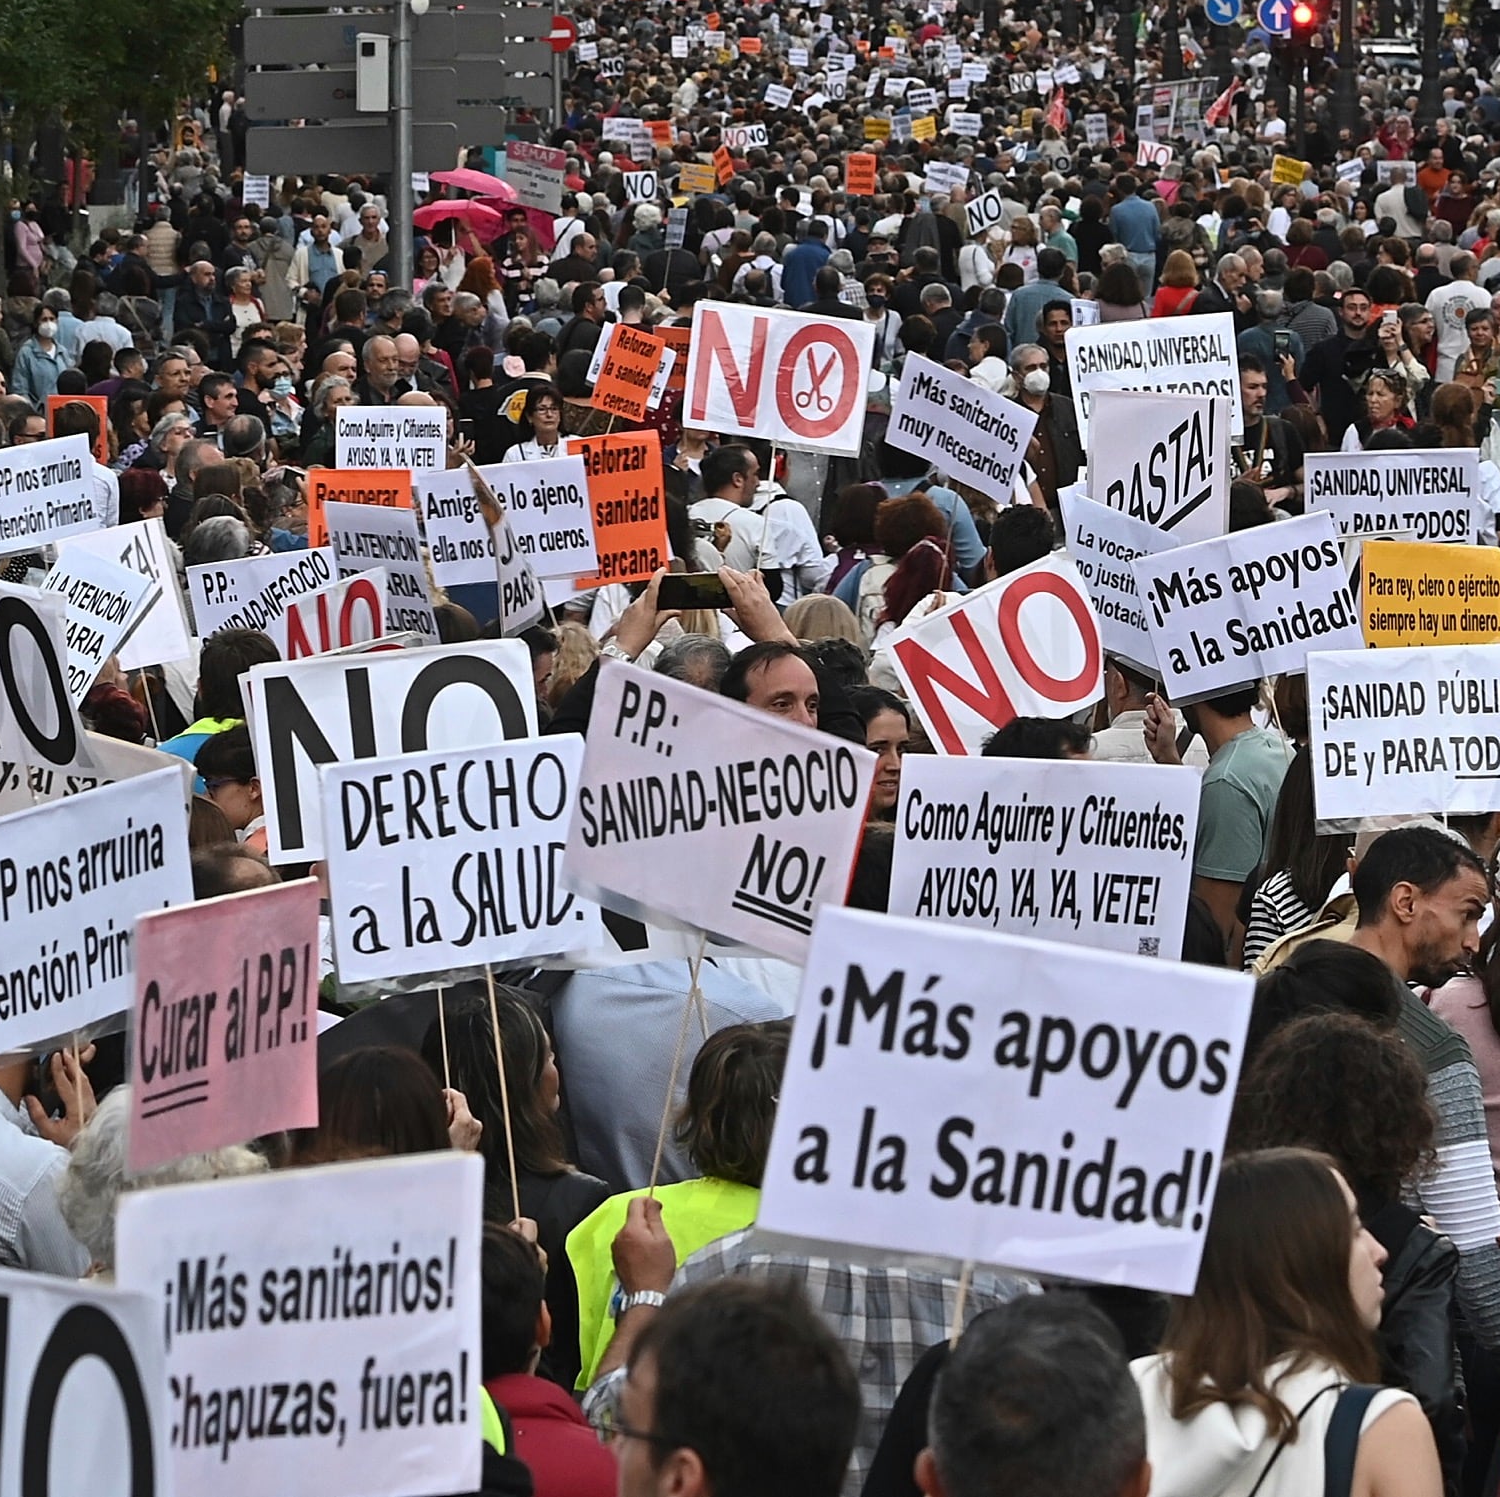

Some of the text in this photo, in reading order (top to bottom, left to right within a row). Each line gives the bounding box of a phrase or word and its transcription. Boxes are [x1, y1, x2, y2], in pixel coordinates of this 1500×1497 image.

[602, 58, 624, 76] NO
[1011, 72, 1034, 92] NO
[724, 129, 747, 147] NO
[1139, 143, 1171, 167] NO
[625, 173, 655, 199] NO
[967, 194, 1002, 232] NO
[602, 356, 655, 389] la sanidad
[690, 309, 861, 438] NO
[338, 418, 444, 442] Como Aguirre y Cifuentes,
[908, 371, 1020, 453] ¡Más sanitarios,
[347, 447, 436, 468] AYUSO, YA, YA, VETE!
[897, 412, 1015, 488] muy necesarios!
[15, 468, 40, 494] nos
[40, 454, 82, 487] arruina
[1310, 466, 1471, 503] ¡SANIDAD, UNIVERSAL,
[595, 485, 660, 528] sanidad
[432, 535, 458, 563] ella
[461, 538, 484, 559] nos
[539, 526, 590, 551] cueros.
[1075, 559, 1093, 579] no
[1147, 539, 1339, 628] ¡Más apoyos
[1368, 572, 1500, 603] Para rey, clero o ejército
[1168, 587, 1359, 675] a la Sanidad!
[1369, 607, 1500, 638] siempre hay un dinero.
[894, 571, 1101, 755] NO
[614, 679, 680, 758] P.P.:
[1321, 683, 1425, 731] ¡SANIDAD
[340, 752, 566, 852] DERECHO
[578, 745, 859, 849] SANIDAD-NEGOCIO
[904, 788, 1188, 862] Como Aguirre y Cifuentes,
[26, 857, 73, 910] nos
[77, 817, 165, 897] arruina
[810, 963, 1232, 1110] ¡Más apoyos
[793, 1106, 1215, 1232] a la Sanidad!
[164, 1237, 457, 1352] ¡Más sanitarios!
